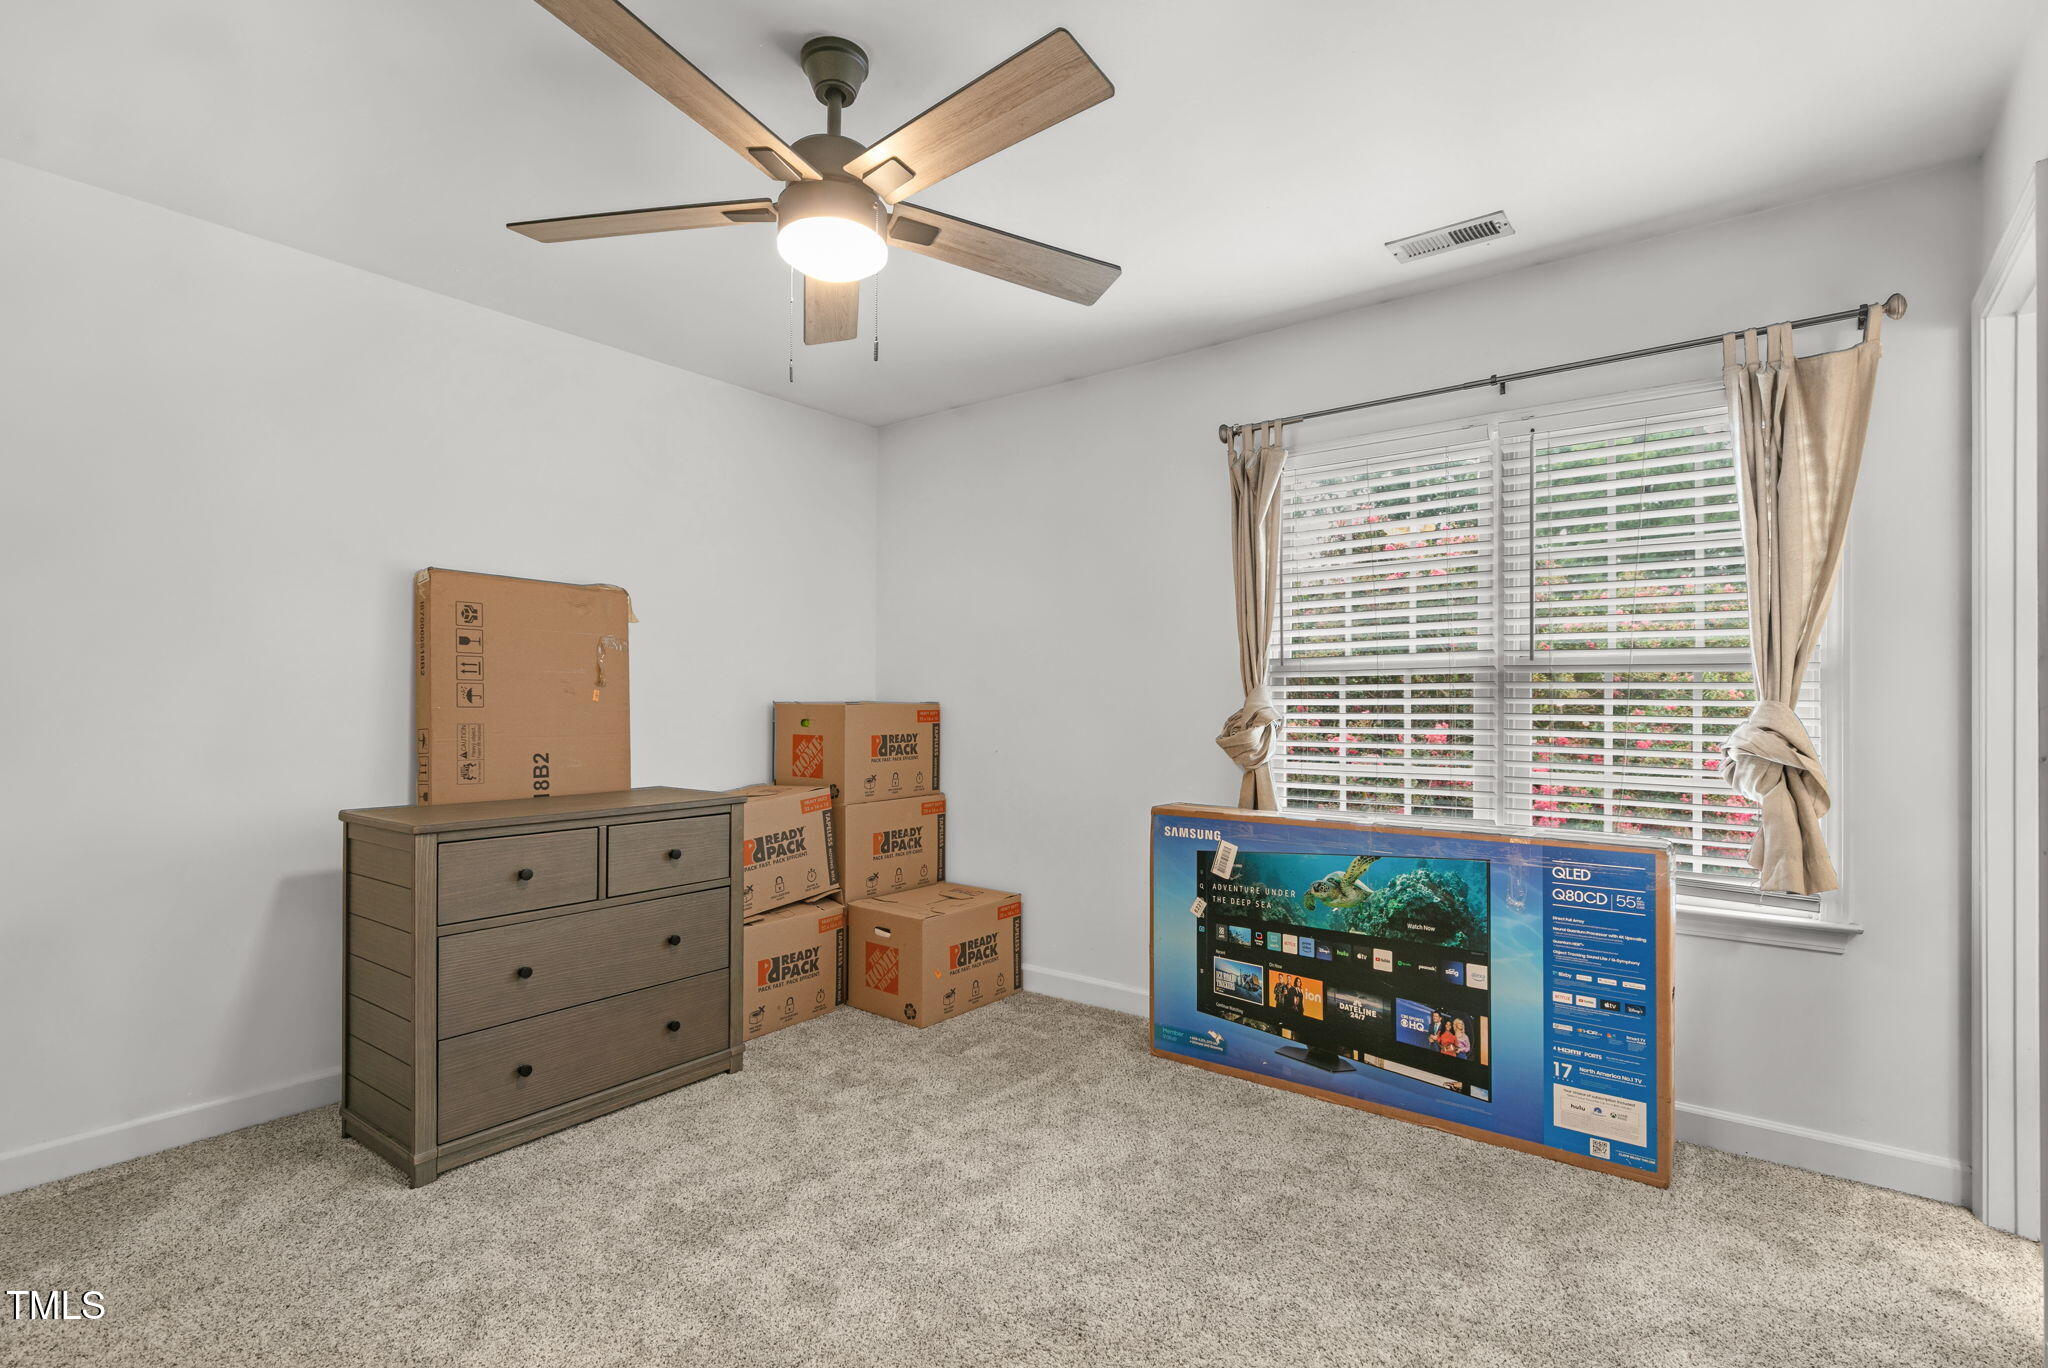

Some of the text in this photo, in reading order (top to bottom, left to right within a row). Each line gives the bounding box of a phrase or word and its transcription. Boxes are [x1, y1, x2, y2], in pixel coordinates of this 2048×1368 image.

[889, 733, 918, 743] READY
[889, 744, 918, 756] PACK
[765, 827, 805, 845] READY
[891, 826, 922, 838] READY
[1164, 826, 1221, 841] SAMSUNG
[767, 838, 806, 858] PACK
[891, 838, 922, 852] PACK
[744, 864, 757, 872] PACK
[773, 857, 786, 865] PACK
[1552, 866, 1591, 880] QLED
[1212, 883, 1296, 898] ADVENTURE UNDER
[1552, 888, 1608, 905] Q80CD
[1212, 896, 1272, 909] THE DEEP SEA
[1423, 924, 1436, 932] Now
[968, 933, 998, 950] READY
[782, 946, 820, 965] READY
[968, 944, 998, 964] PACK
[782, 958, 819, 980] PACK
[1305, 989, 1320, 1003] ion
[1340, 1003, 1377, 1018] DATELINE
[1350, 1012, 1365, 1020] 24/7
[1163, 1027, 1184, 1036] Member
[1409, 1021, 1425, 1031] HQ
[1584, 1052, 1602, 1060] PORTS
[1553, 1061, 1572, 1079] 17
[1579, 1067, 1596, 1075] North
[1596, 1071, 1622, 1080] America
